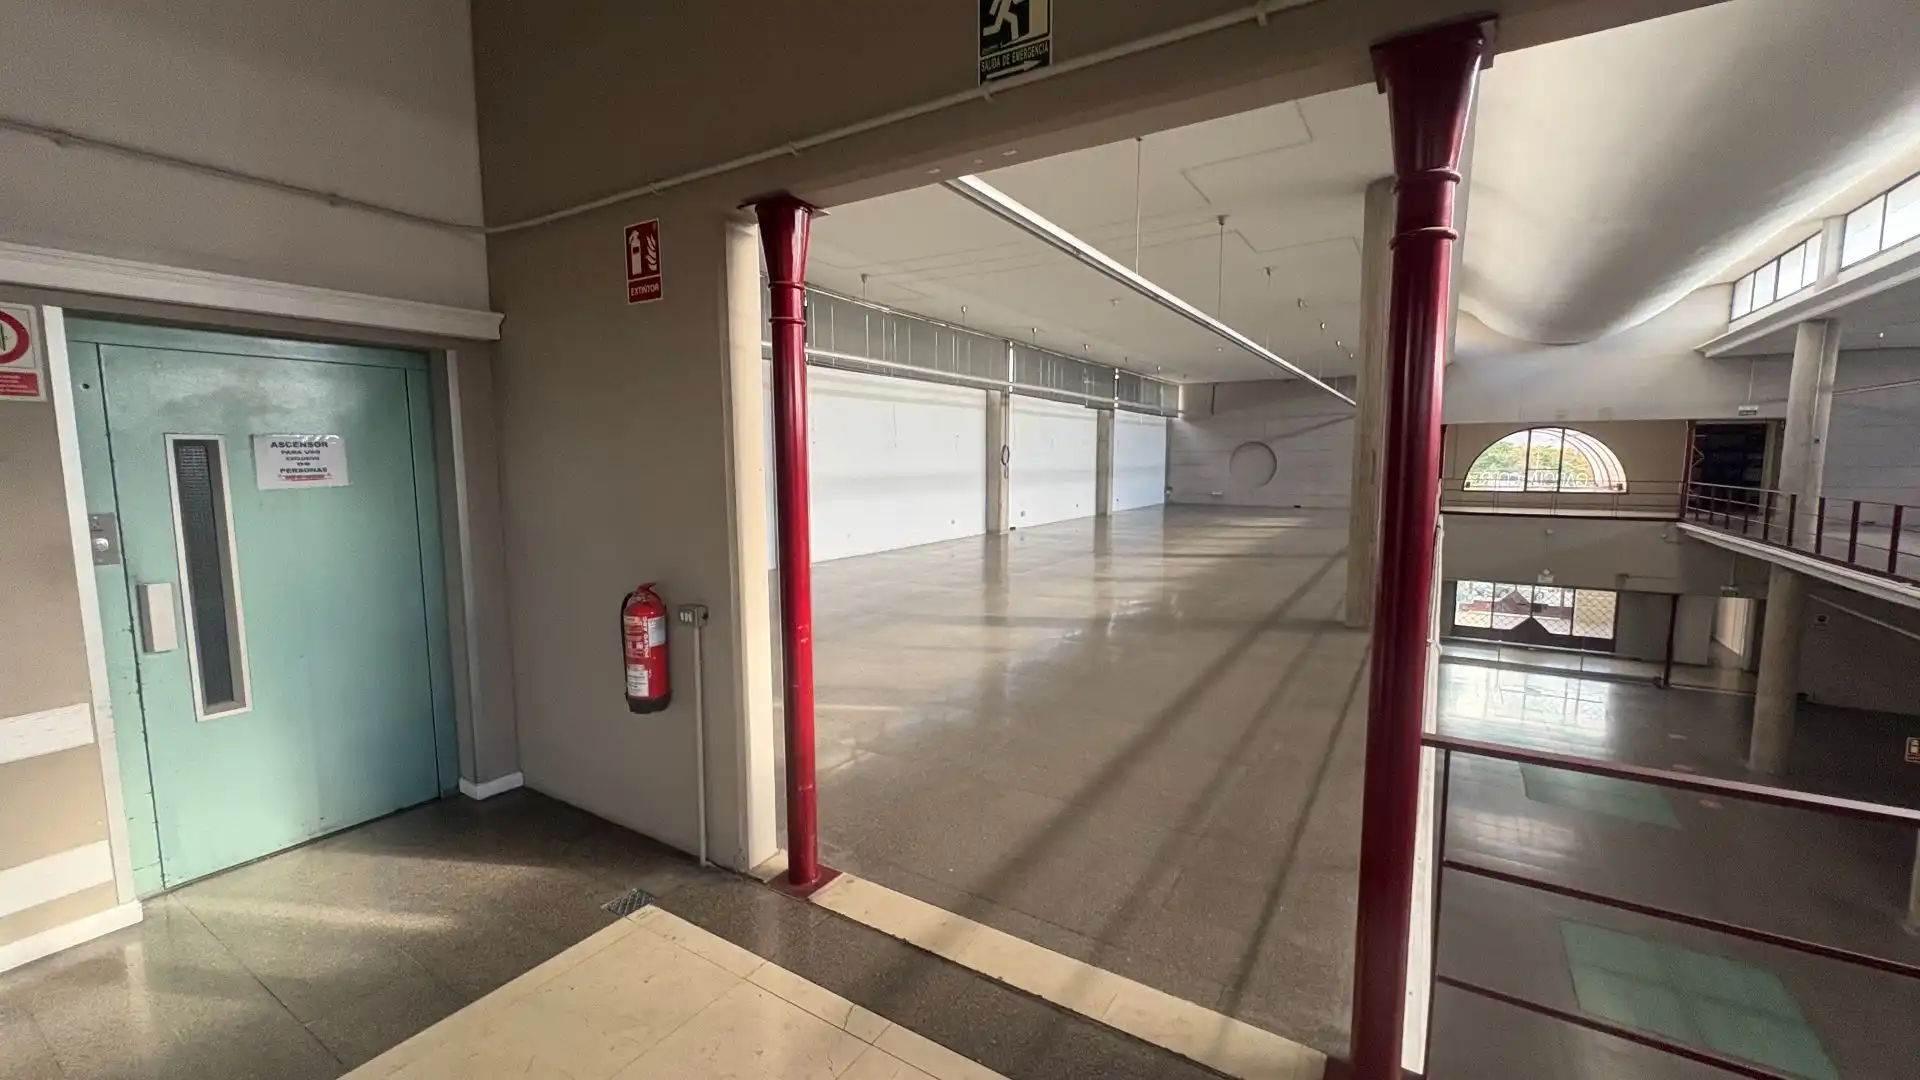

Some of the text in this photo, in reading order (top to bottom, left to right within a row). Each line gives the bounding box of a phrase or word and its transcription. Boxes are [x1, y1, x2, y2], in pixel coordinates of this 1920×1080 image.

[981, 42, 1048, 72] SALIDA DE EMERGENCIA
[631, 283, 659, 296] EXTINTOR
